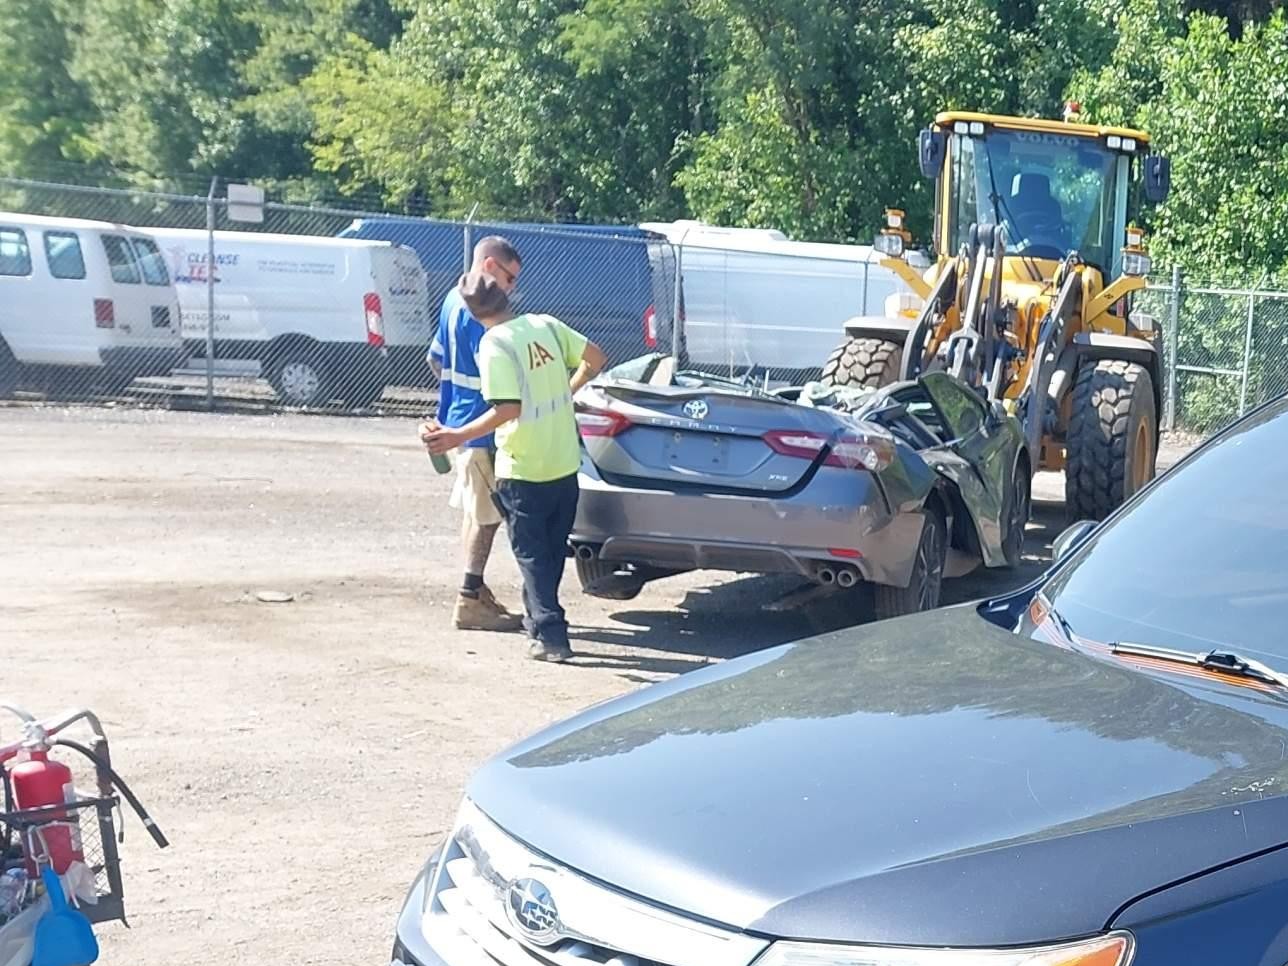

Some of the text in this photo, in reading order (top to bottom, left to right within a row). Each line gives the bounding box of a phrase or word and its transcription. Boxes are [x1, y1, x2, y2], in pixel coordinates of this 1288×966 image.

[1016, 132, 1080, 147] VOLVO
[187, 252, 240, 267] CLENSE
[527, 341, 554, 370] IAA
